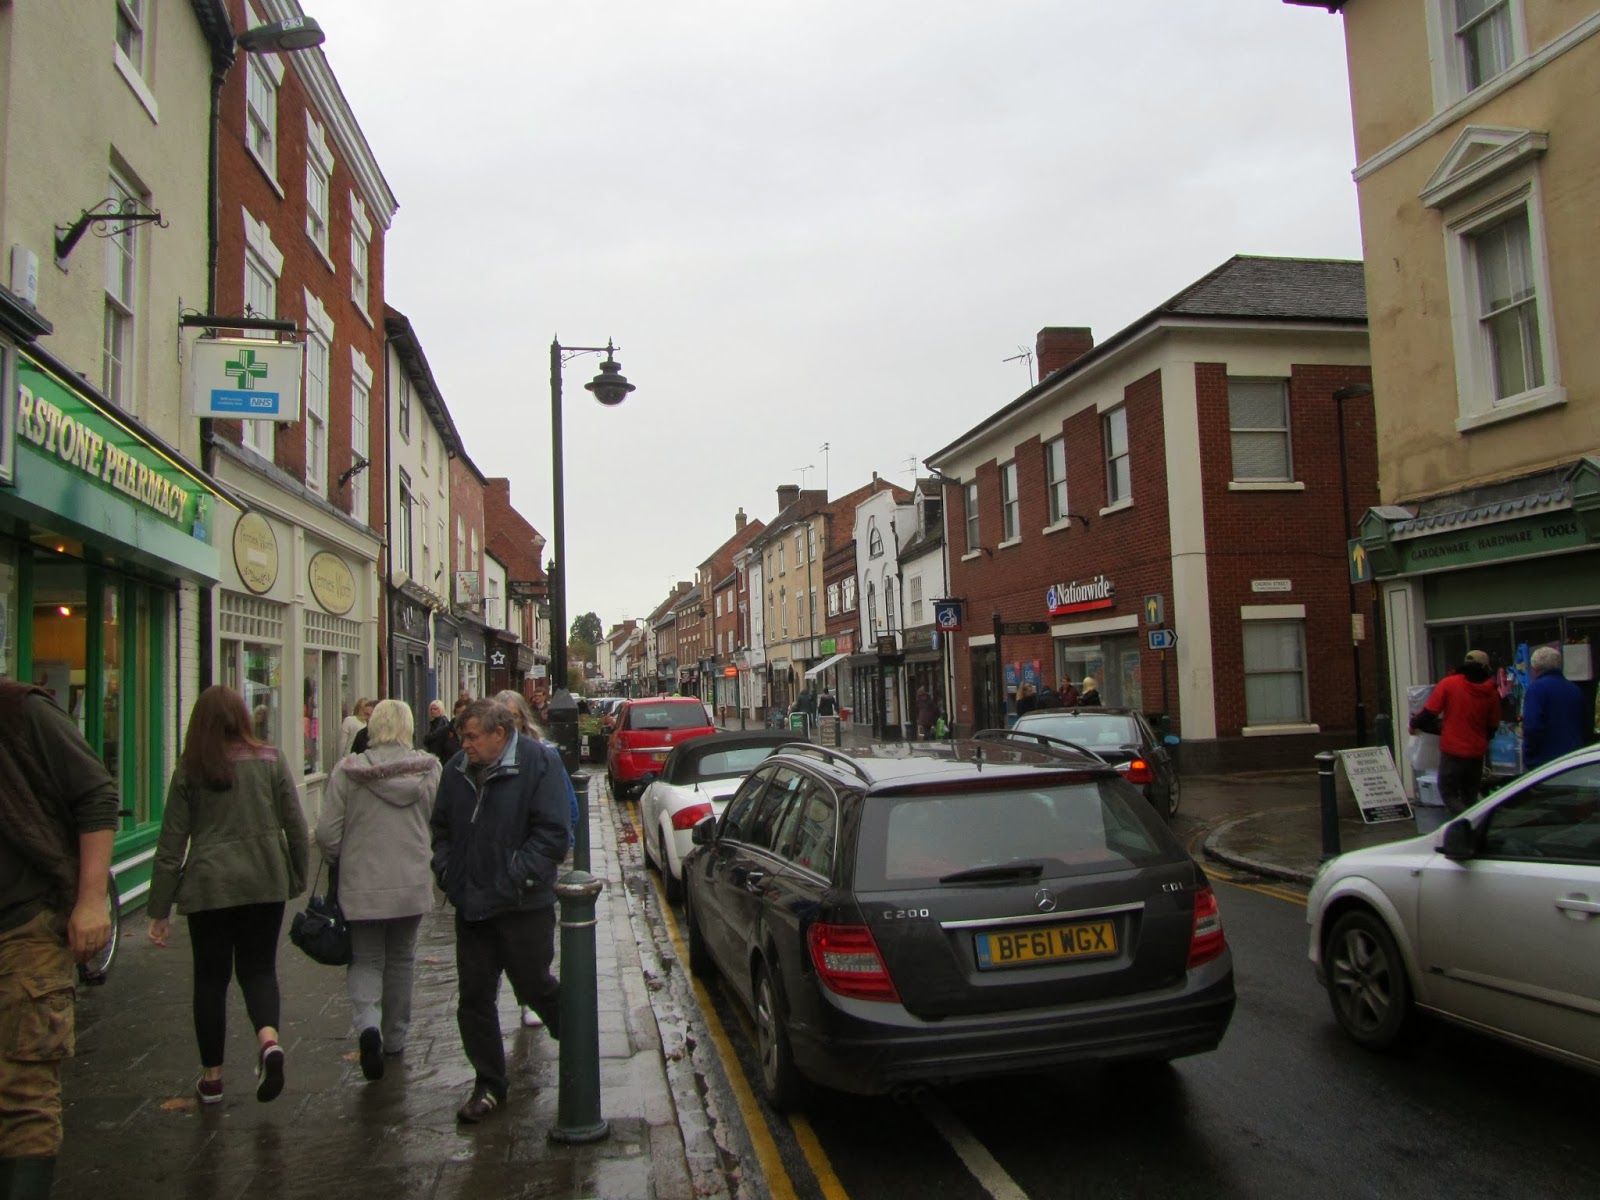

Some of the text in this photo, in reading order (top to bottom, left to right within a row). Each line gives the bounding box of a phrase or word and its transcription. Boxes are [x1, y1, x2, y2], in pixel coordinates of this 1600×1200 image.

[251, 398, 272, 407] NHS
[17, 383, 188, 523] RSTONE PHARMACY
[1411, 522, 1577, 561] GARDENWARE HARDWARE TOOLS
[1057, 575, 1110, 606] Nationwide
[1153, 633, 1162, 646] P
[1162, 881, 1183, 892] CDI
[998, 925, 1108, 961] BF61 WGX
